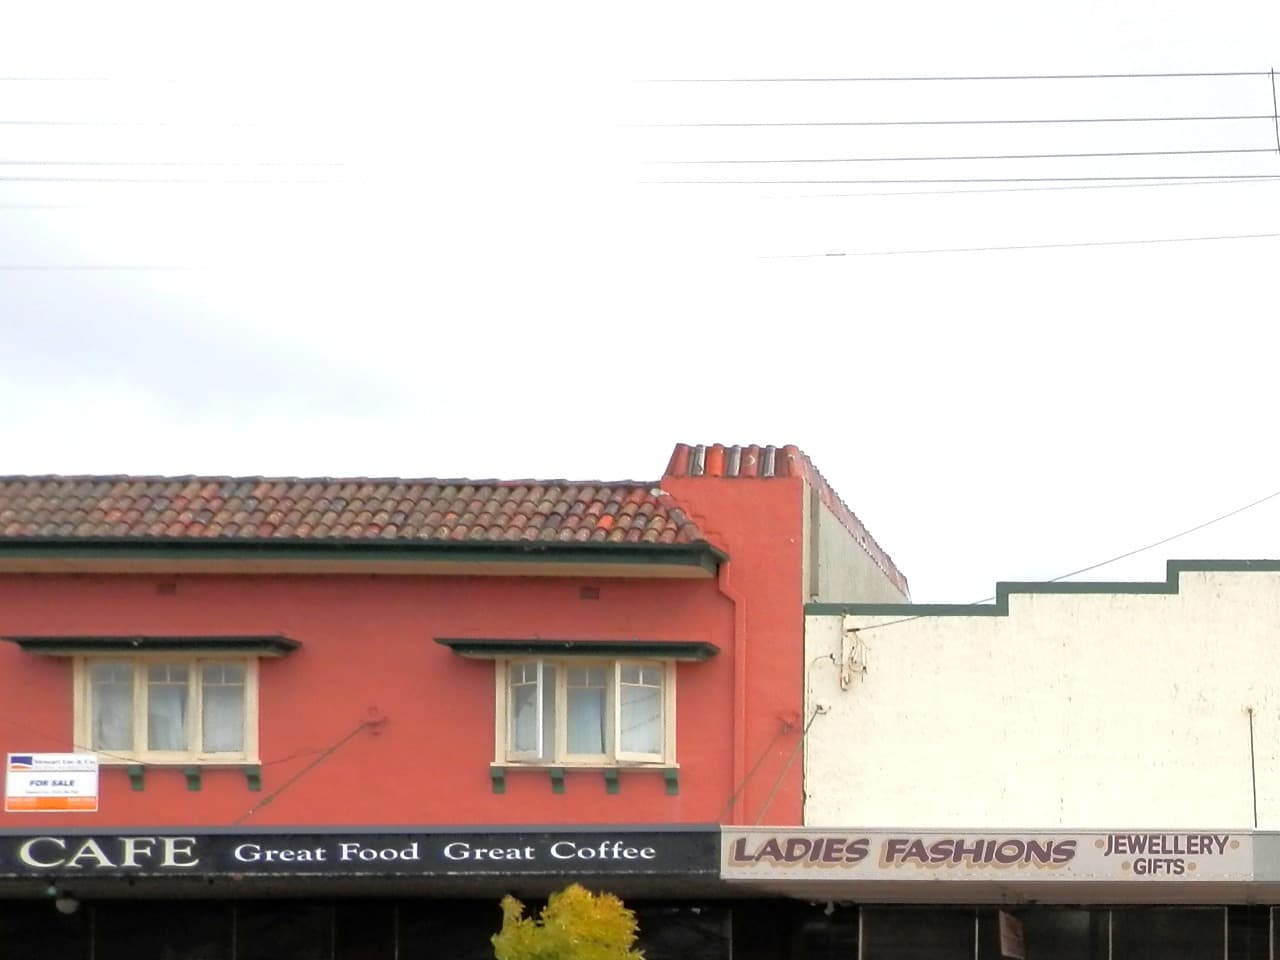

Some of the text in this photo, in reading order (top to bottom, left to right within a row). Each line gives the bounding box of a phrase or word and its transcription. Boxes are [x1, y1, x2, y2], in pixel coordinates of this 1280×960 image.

[19, 836, 657, 868] CAFE Great Food Great Coffee
[732, 837, 1077, 865] LADIES FASHIONS
[1103, 833, 1230, 857] JEWELLERY
[1133, 857, 1185, 875] GIFTS
